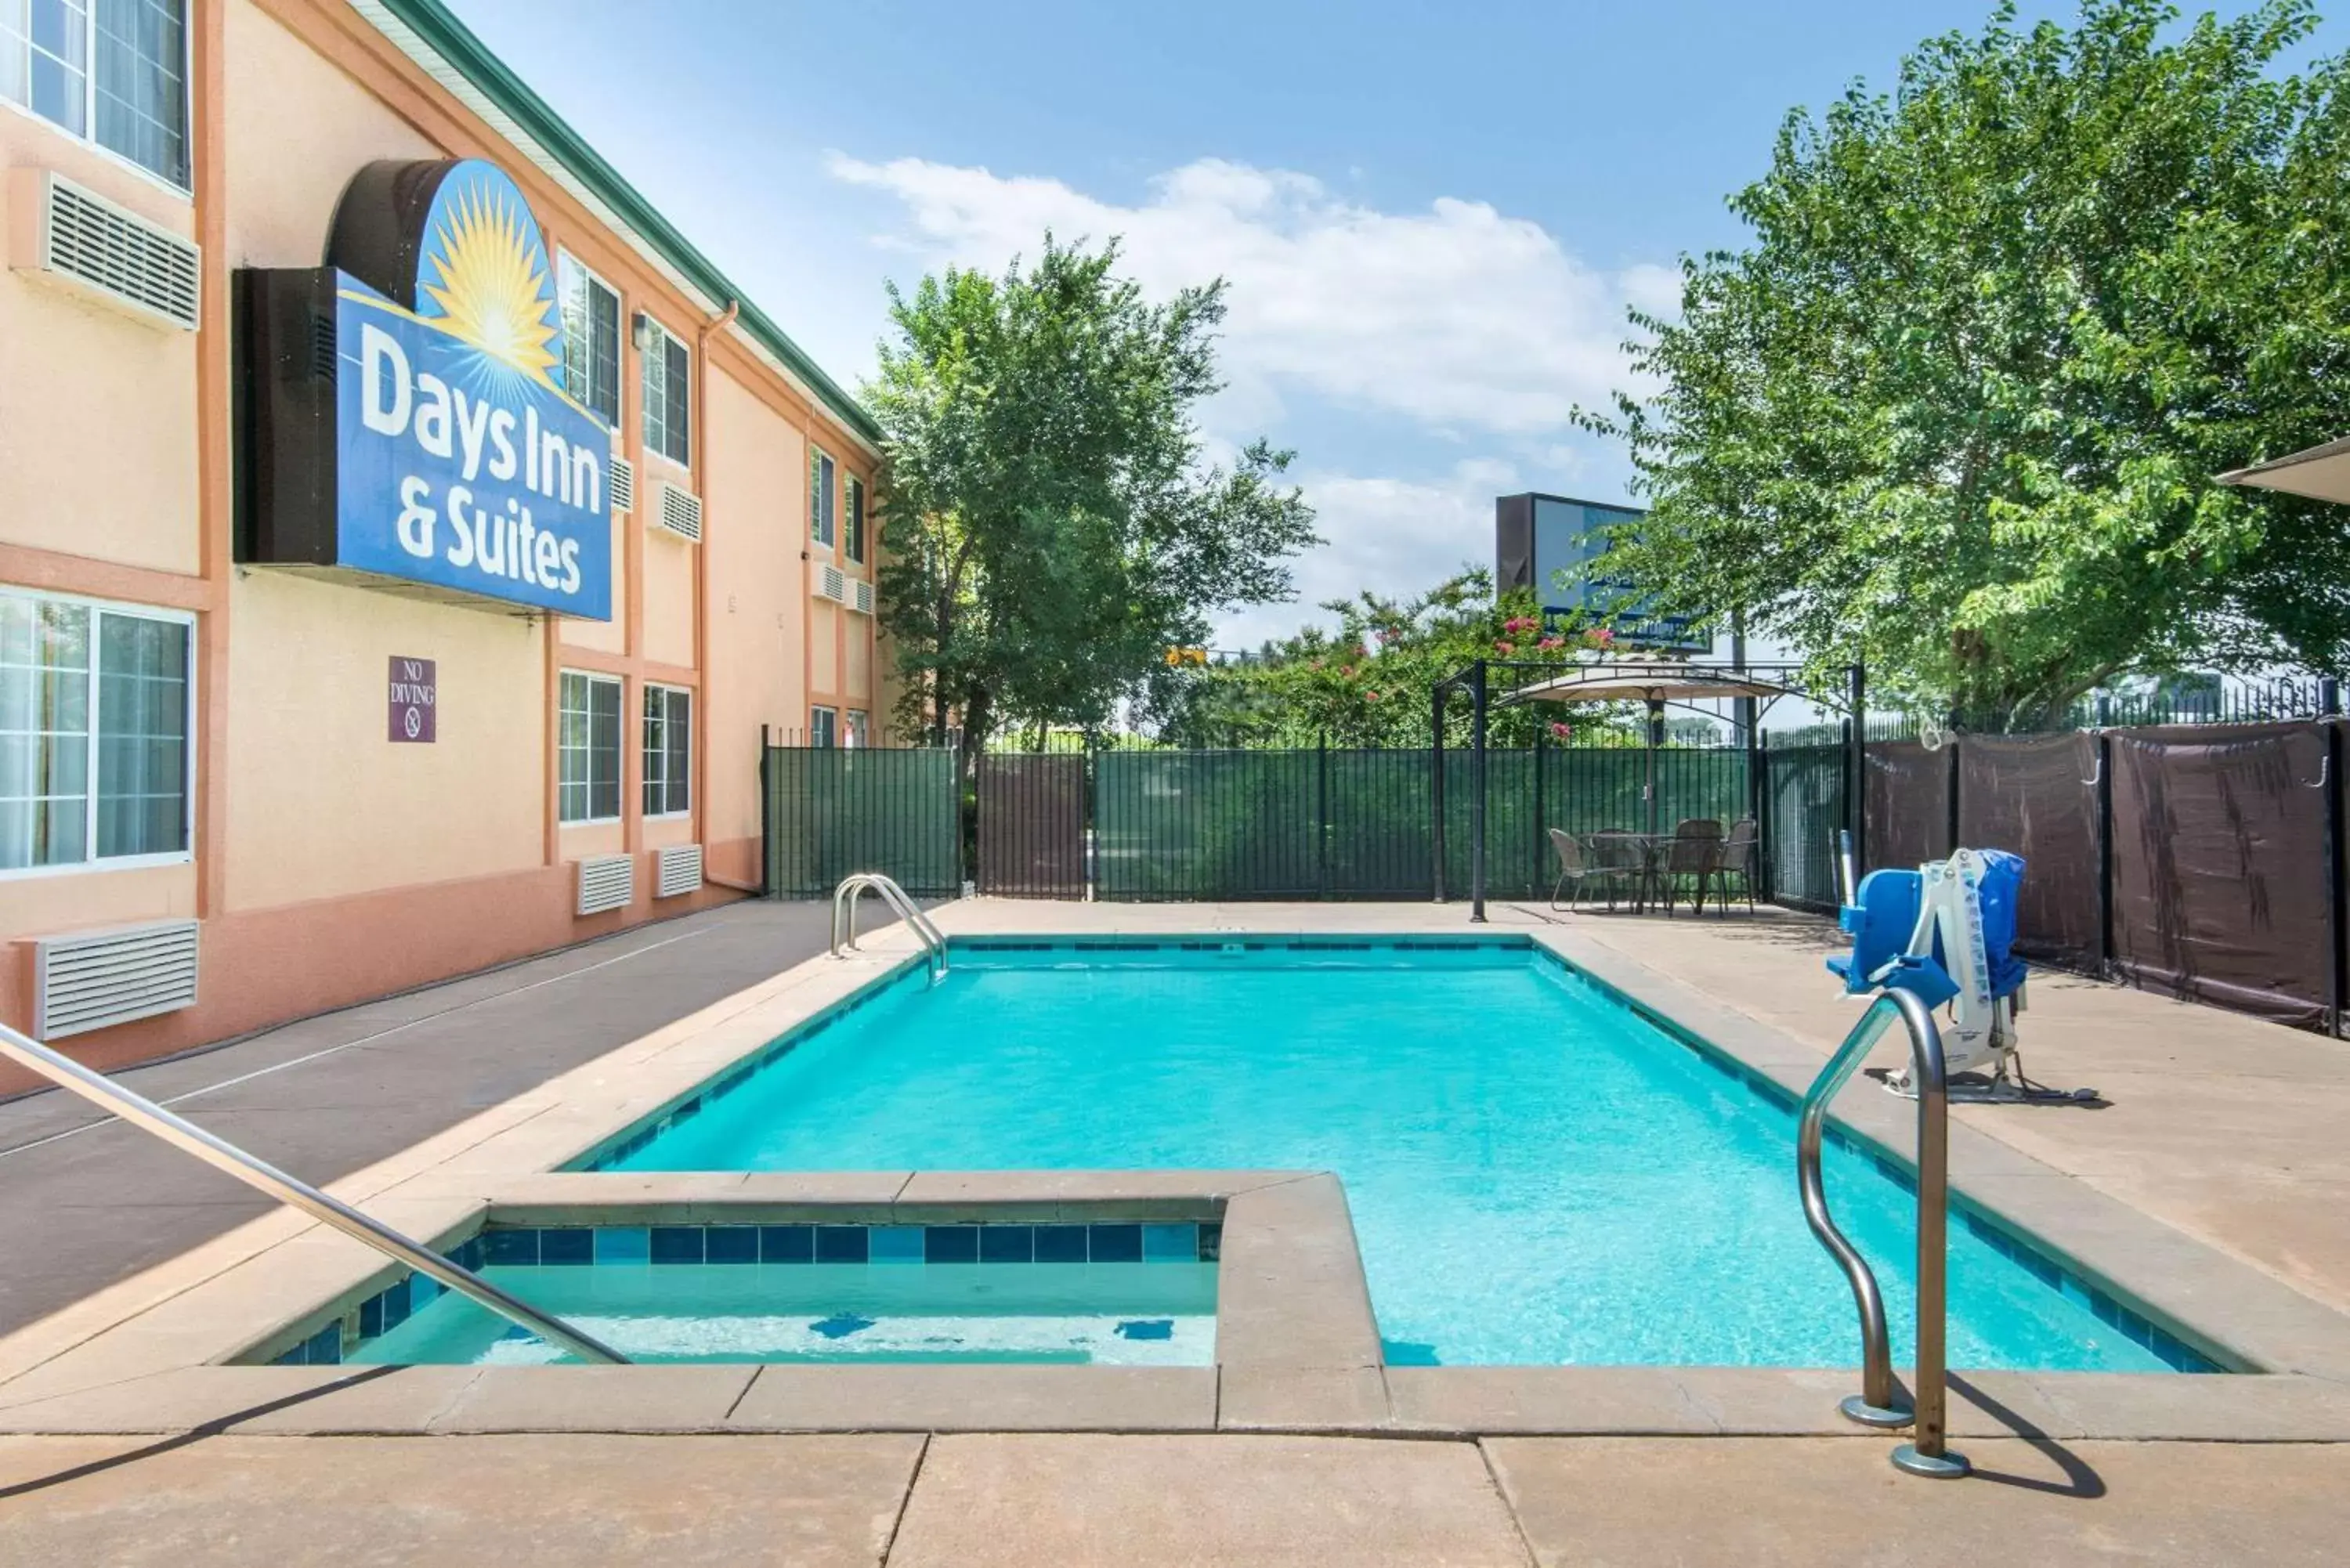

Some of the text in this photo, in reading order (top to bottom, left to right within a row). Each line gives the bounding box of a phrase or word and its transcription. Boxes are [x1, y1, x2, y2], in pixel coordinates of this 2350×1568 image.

[362, 322, 600, 514] Days Inn
[397, 475, 580, 594] & Suites
[390, 682, 434, 704] DIVING
[403, 660, 422, 681] NO
